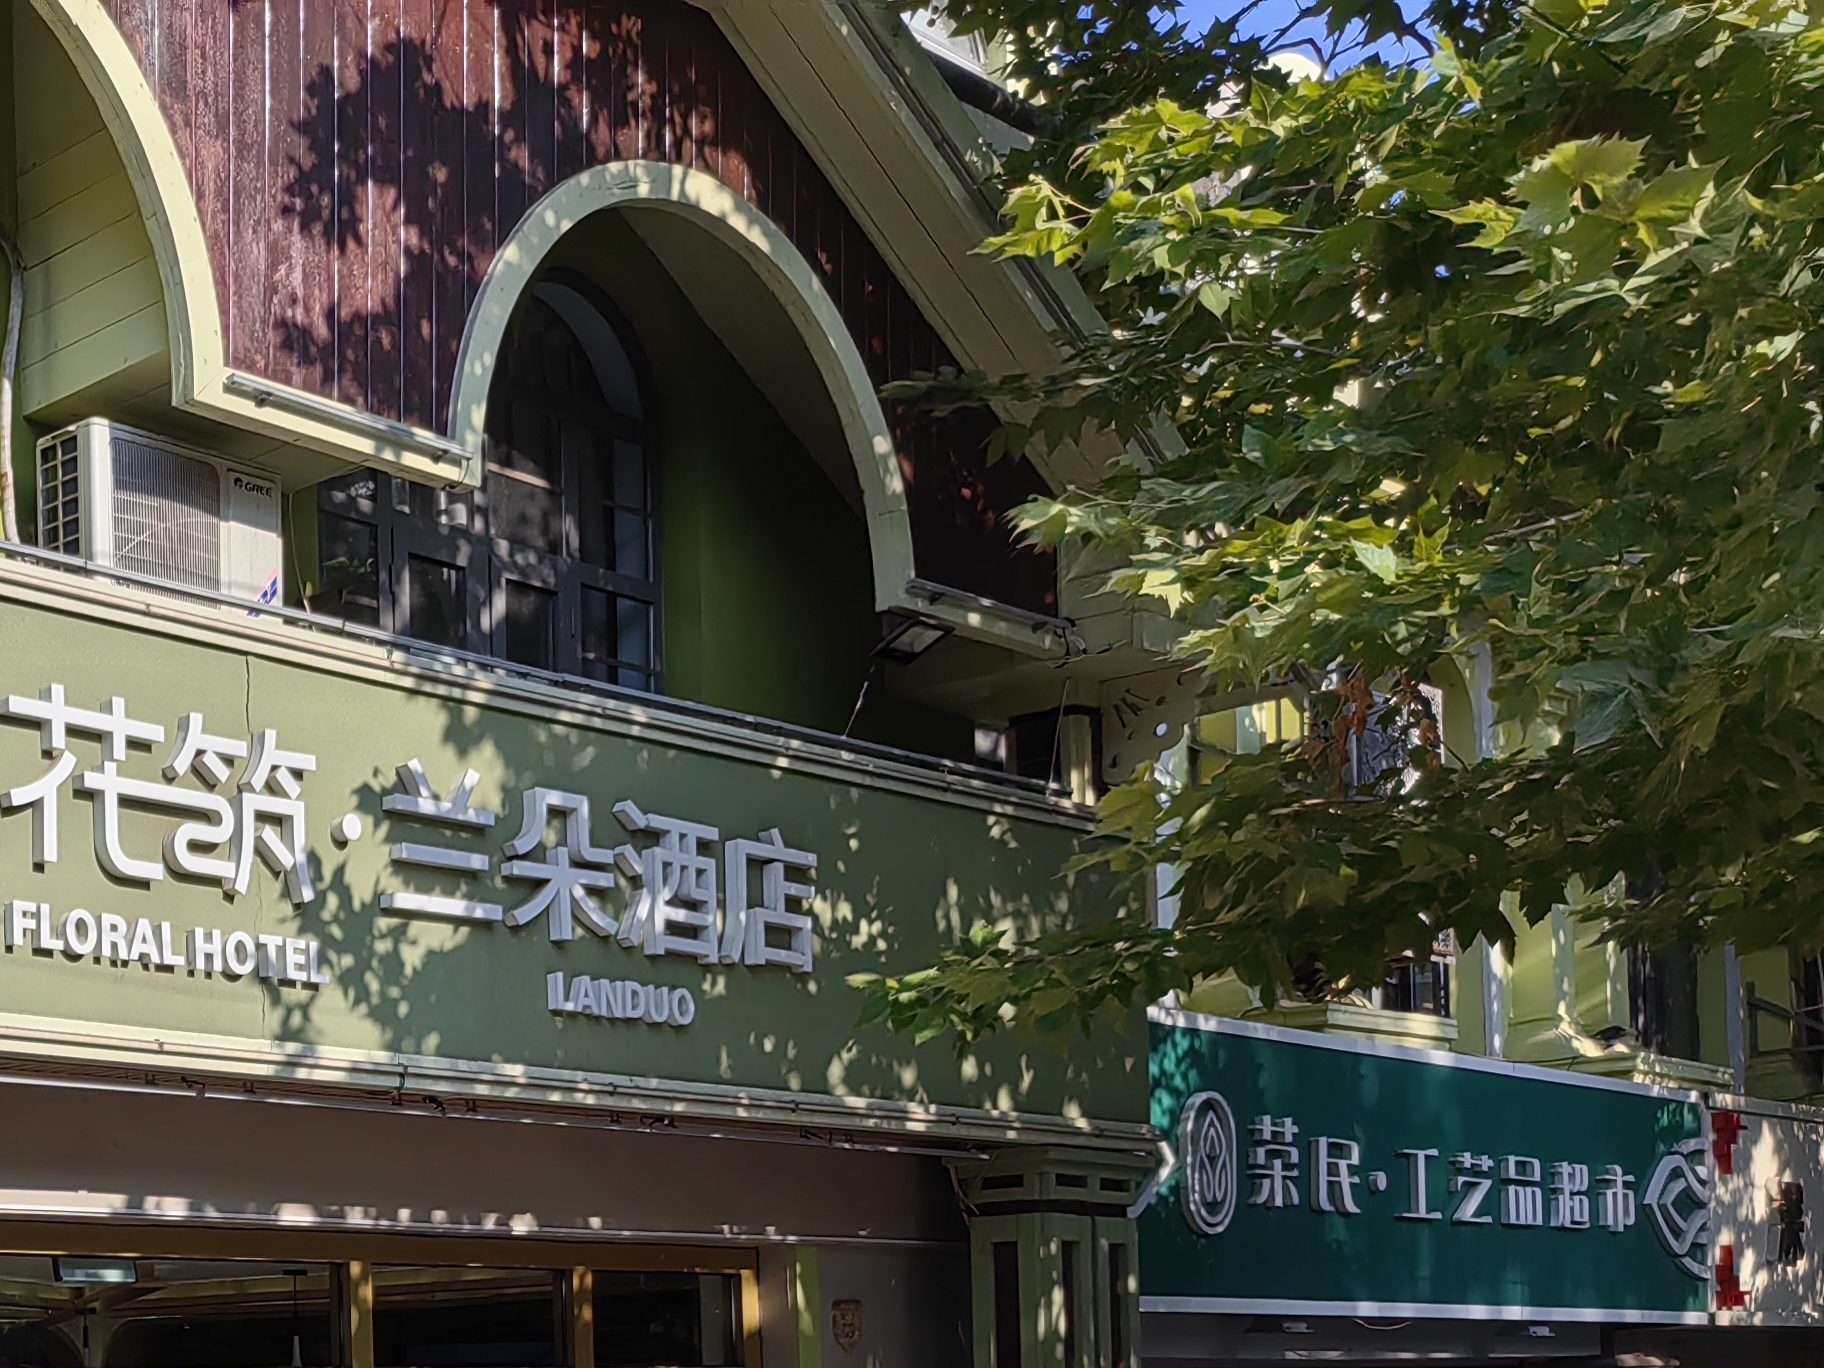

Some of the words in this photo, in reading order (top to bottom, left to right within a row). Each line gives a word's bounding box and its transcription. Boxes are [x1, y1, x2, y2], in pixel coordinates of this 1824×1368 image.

[244, 481, 275, 498] GREE
[5, 900, 185, 966] FLORAL
[187, 926, 330, 985] HOTEL
[547, 971, 695, 1026] LANDUO
